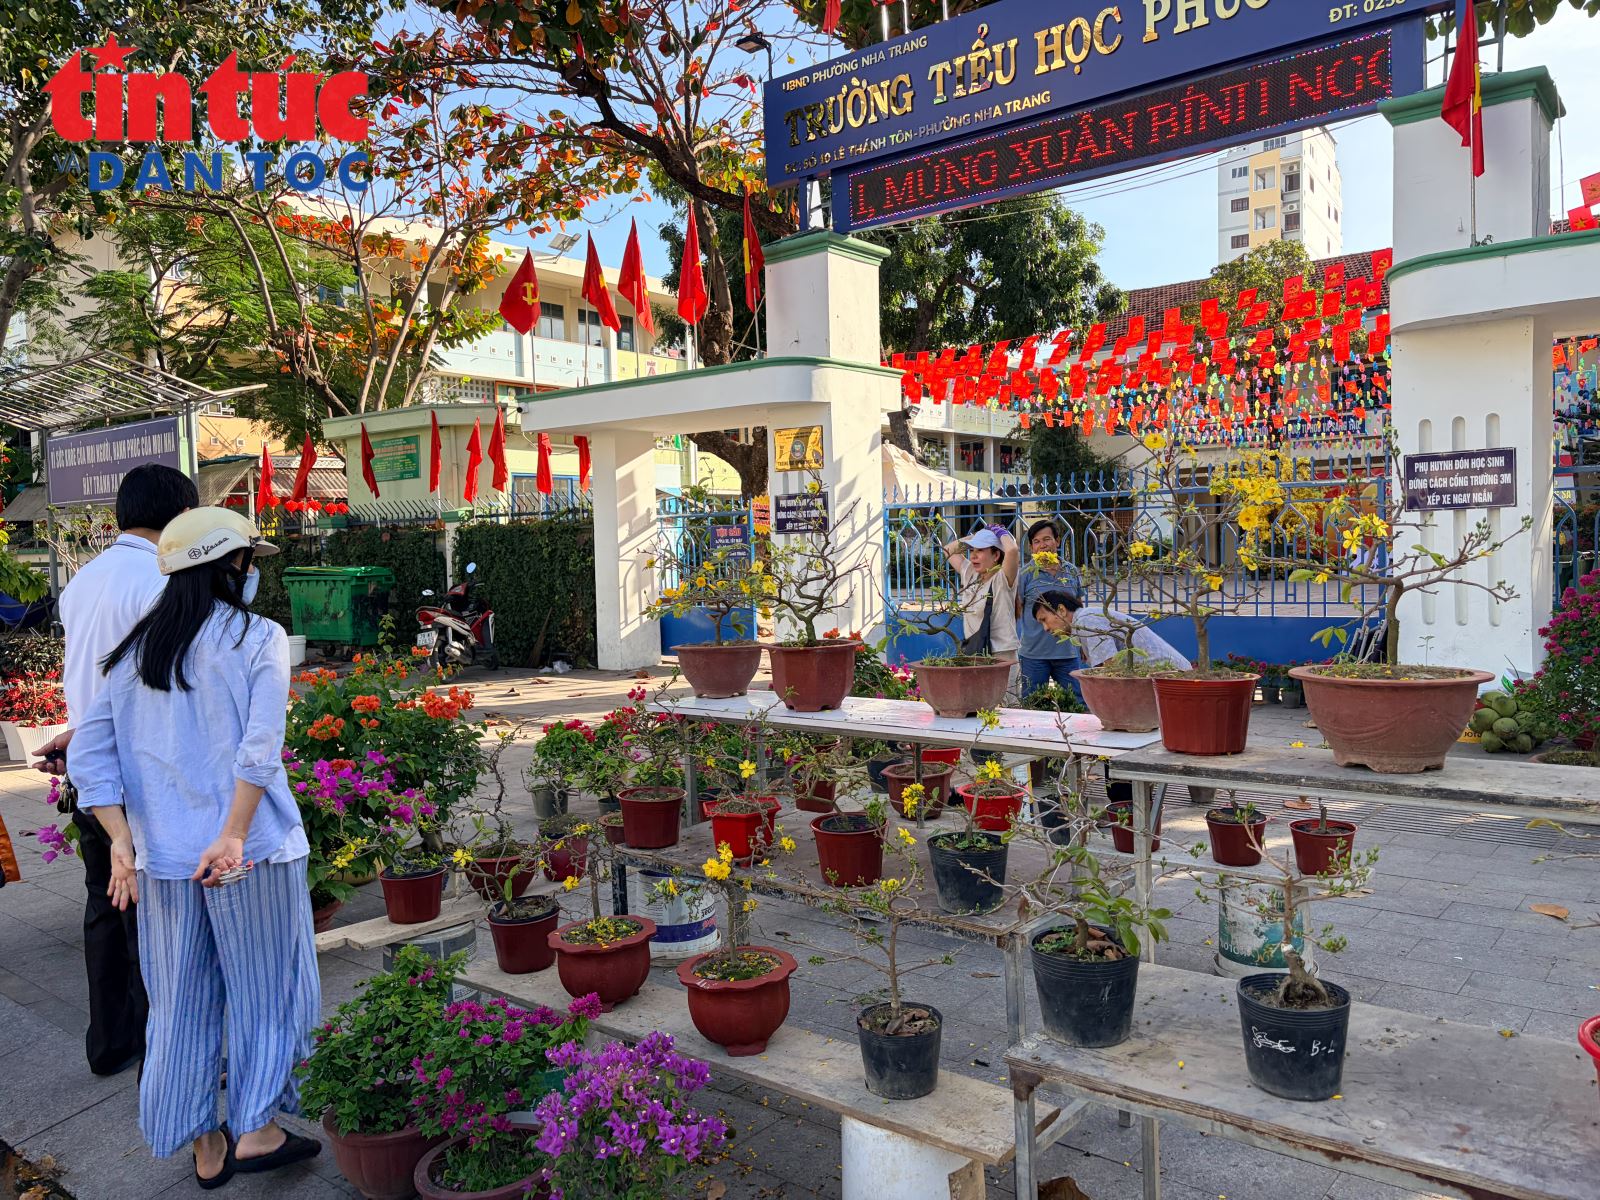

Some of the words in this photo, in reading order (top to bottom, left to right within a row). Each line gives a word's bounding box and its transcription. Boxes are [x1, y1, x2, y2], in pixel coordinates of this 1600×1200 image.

[1328, 3, 1358, 22] ĐT:
[783, 73, 914, 146] TRƯỜNG
[927, 23, 1019, 105] TIỂU
[1034, 6, 1122, 75] HỌC
[812, 60, 859, 83] PHƯỜNG
[861, 50, 886, 67] NHA
[888, 36, 928, 58] TRANG
[848, 138, 886, 157] THÁNH
[974, 105, 1003, 123] NHA
[1005, 90, 1051, 114] TRANG
[1008, 113, 1139, 179] XUÂN
[1414, 462, 1429, 475] PHỤ
[1430, 459, 1454, 471] HUYNH
[1454, 457, 1470, 470] ĐÓN
[1471, 457, 1486, 471] HỌC
[1487, 455, 1505, 467] SINH
[1429, 475, 1448, 489] CÁCH
[1449, 472, 1469, 487] CỔNG
[1469, 472, 1499, 486] TRƯỜNG
[1500, 473, 1512, 485] 3M
[1427, 491, 1441, 506] XẾP
[1442, 493, 1452, 505] XE
[1453, 492, 1471, 504] NGAY
[1472, 489, 1493, 503] NGẮN
